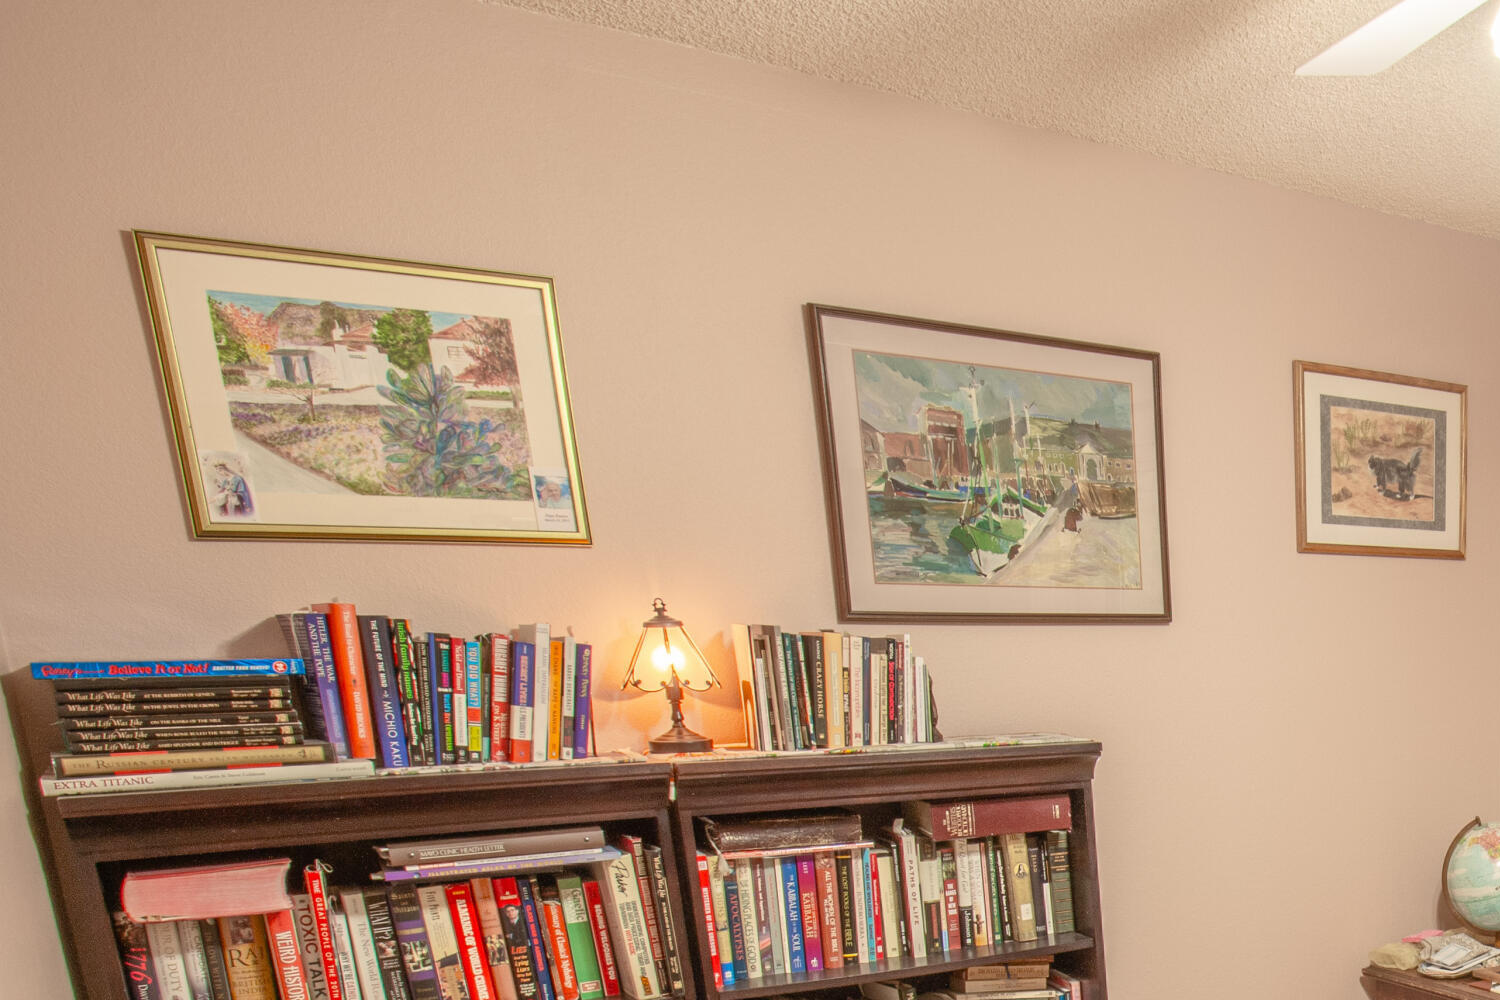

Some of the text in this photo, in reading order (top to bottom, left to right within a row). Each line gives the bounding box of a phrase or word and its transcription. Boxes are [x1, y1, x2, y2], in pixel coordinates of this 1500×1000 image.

[308, 623, 325, 677] AND THE POPE
[372, 632, 382, 651] FUTURE
[323, 647, 332, 662] THE
[377, 662, 385, 671] THE
[109, 665, 152, 675] Believe
[155, 664, 165, 674] It
[183, 663, 210, 673] Not!
[379, 673, 388, 687] MIND
[400, 644, 410, 670] family
[405, 672, 413, 699] names
[469, 647, 479, 705] YOU DID WHAT?
[383, 701, 403, 766] MICHIO KAKU
[53, 777, 154, 790] EXTRA TITANIC
[312, 880, 321, 894] TIME
[611, 861, 629, 896] Parker
[315, 898, 325, 920] GREAT
[571, 889, 587, 921] Gaelic
[911, 892, 917, 902] OF
[730, 893, 744, 961] APOCALYPSES
[786, 882, 800, 952] KABBALAH SOUL
[802, 893, 813, 938] KABBALAH
[280, 931, 297, 964] WEIRD
[319, 923, 330, 948] PEOPLE
[299, 904, 327, 998] TOXIC TALK
[325, 952, 333, 963] OF
[125, 947, 152, 984] 1776
[327, 965, 336, 977] THE
[330, 981, 339, 998] 20TH
